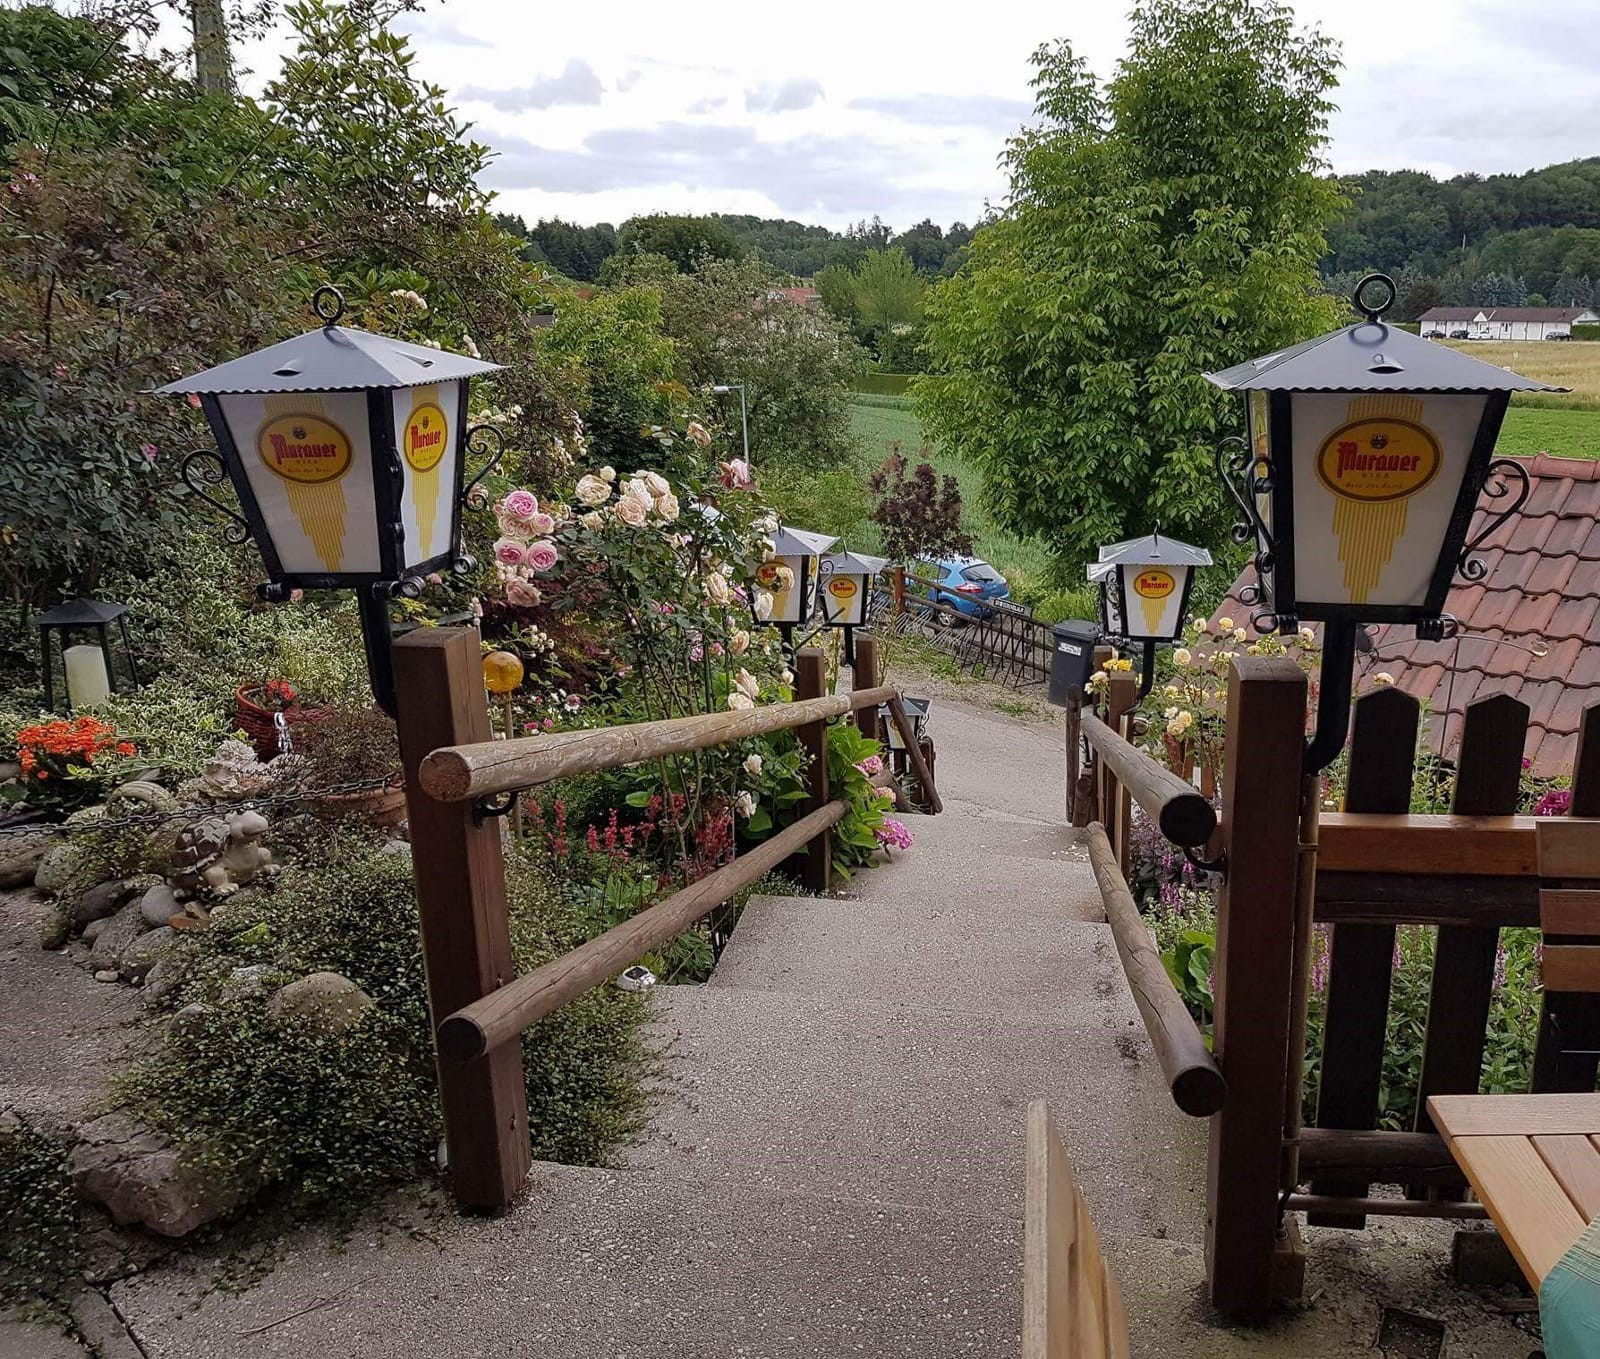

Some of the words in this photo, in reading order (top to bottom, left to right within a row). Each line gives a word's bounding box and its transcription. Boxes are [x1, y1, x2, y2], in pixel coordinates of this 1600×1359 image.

[269, 433, 337, 465] Murauer
[411, 425, 441, 457] Murauer
[1336, 441, 1421, 479] Murauer
